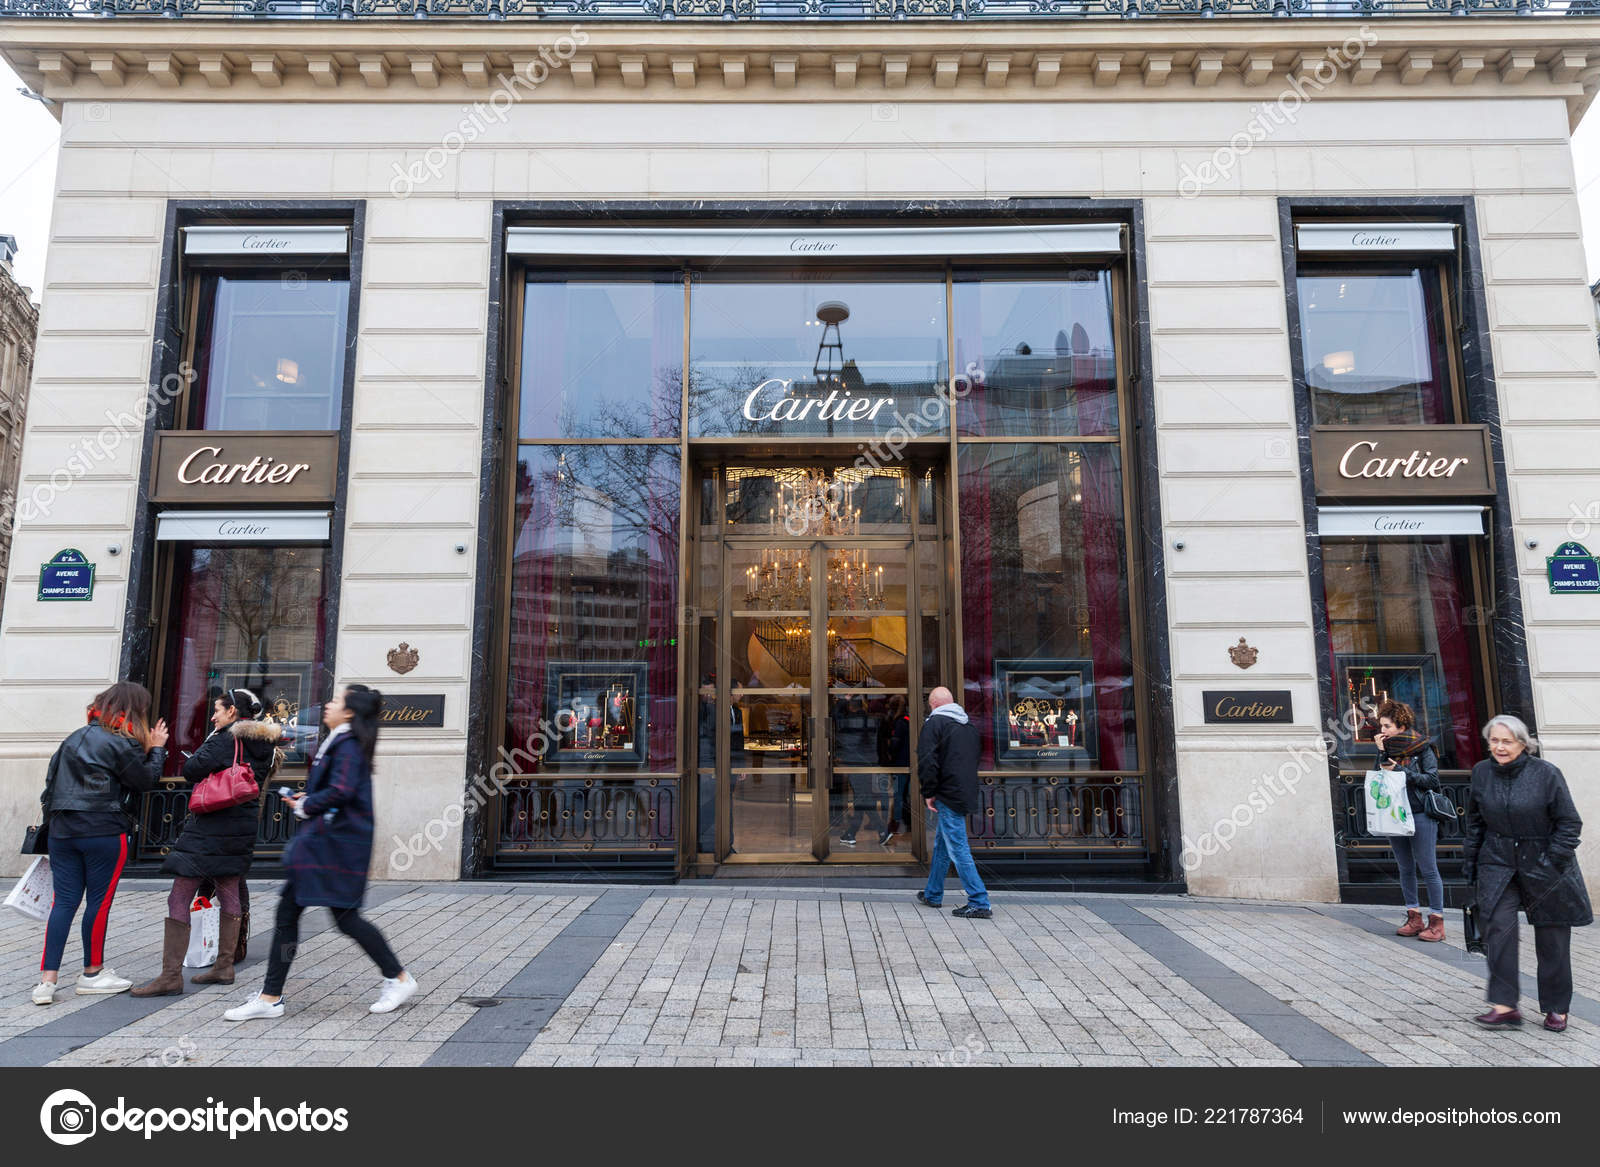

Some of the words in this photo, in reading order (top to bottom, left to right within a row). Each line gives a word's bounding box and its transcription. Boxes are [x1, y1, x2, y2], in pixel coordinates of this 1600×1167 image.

[242, 235, 292, 249] Cartier
[790, 238, 838, 252] Cartier
[1352, 232, 1400, 246] Cartier
[743, 378, 894, 422] Cartier
[177, 446, 311, 484] Cartier
[1338, 440, 1469, 478] Cartier
[218, 519, 270, 535] Cartier
[1374, 515, 1425, 531] Cartier
[1215, 696, 1283, 718] Cartier
[584, 752, 606, 760] Cartier
[1037, 750, 1058, 758] Cartier
